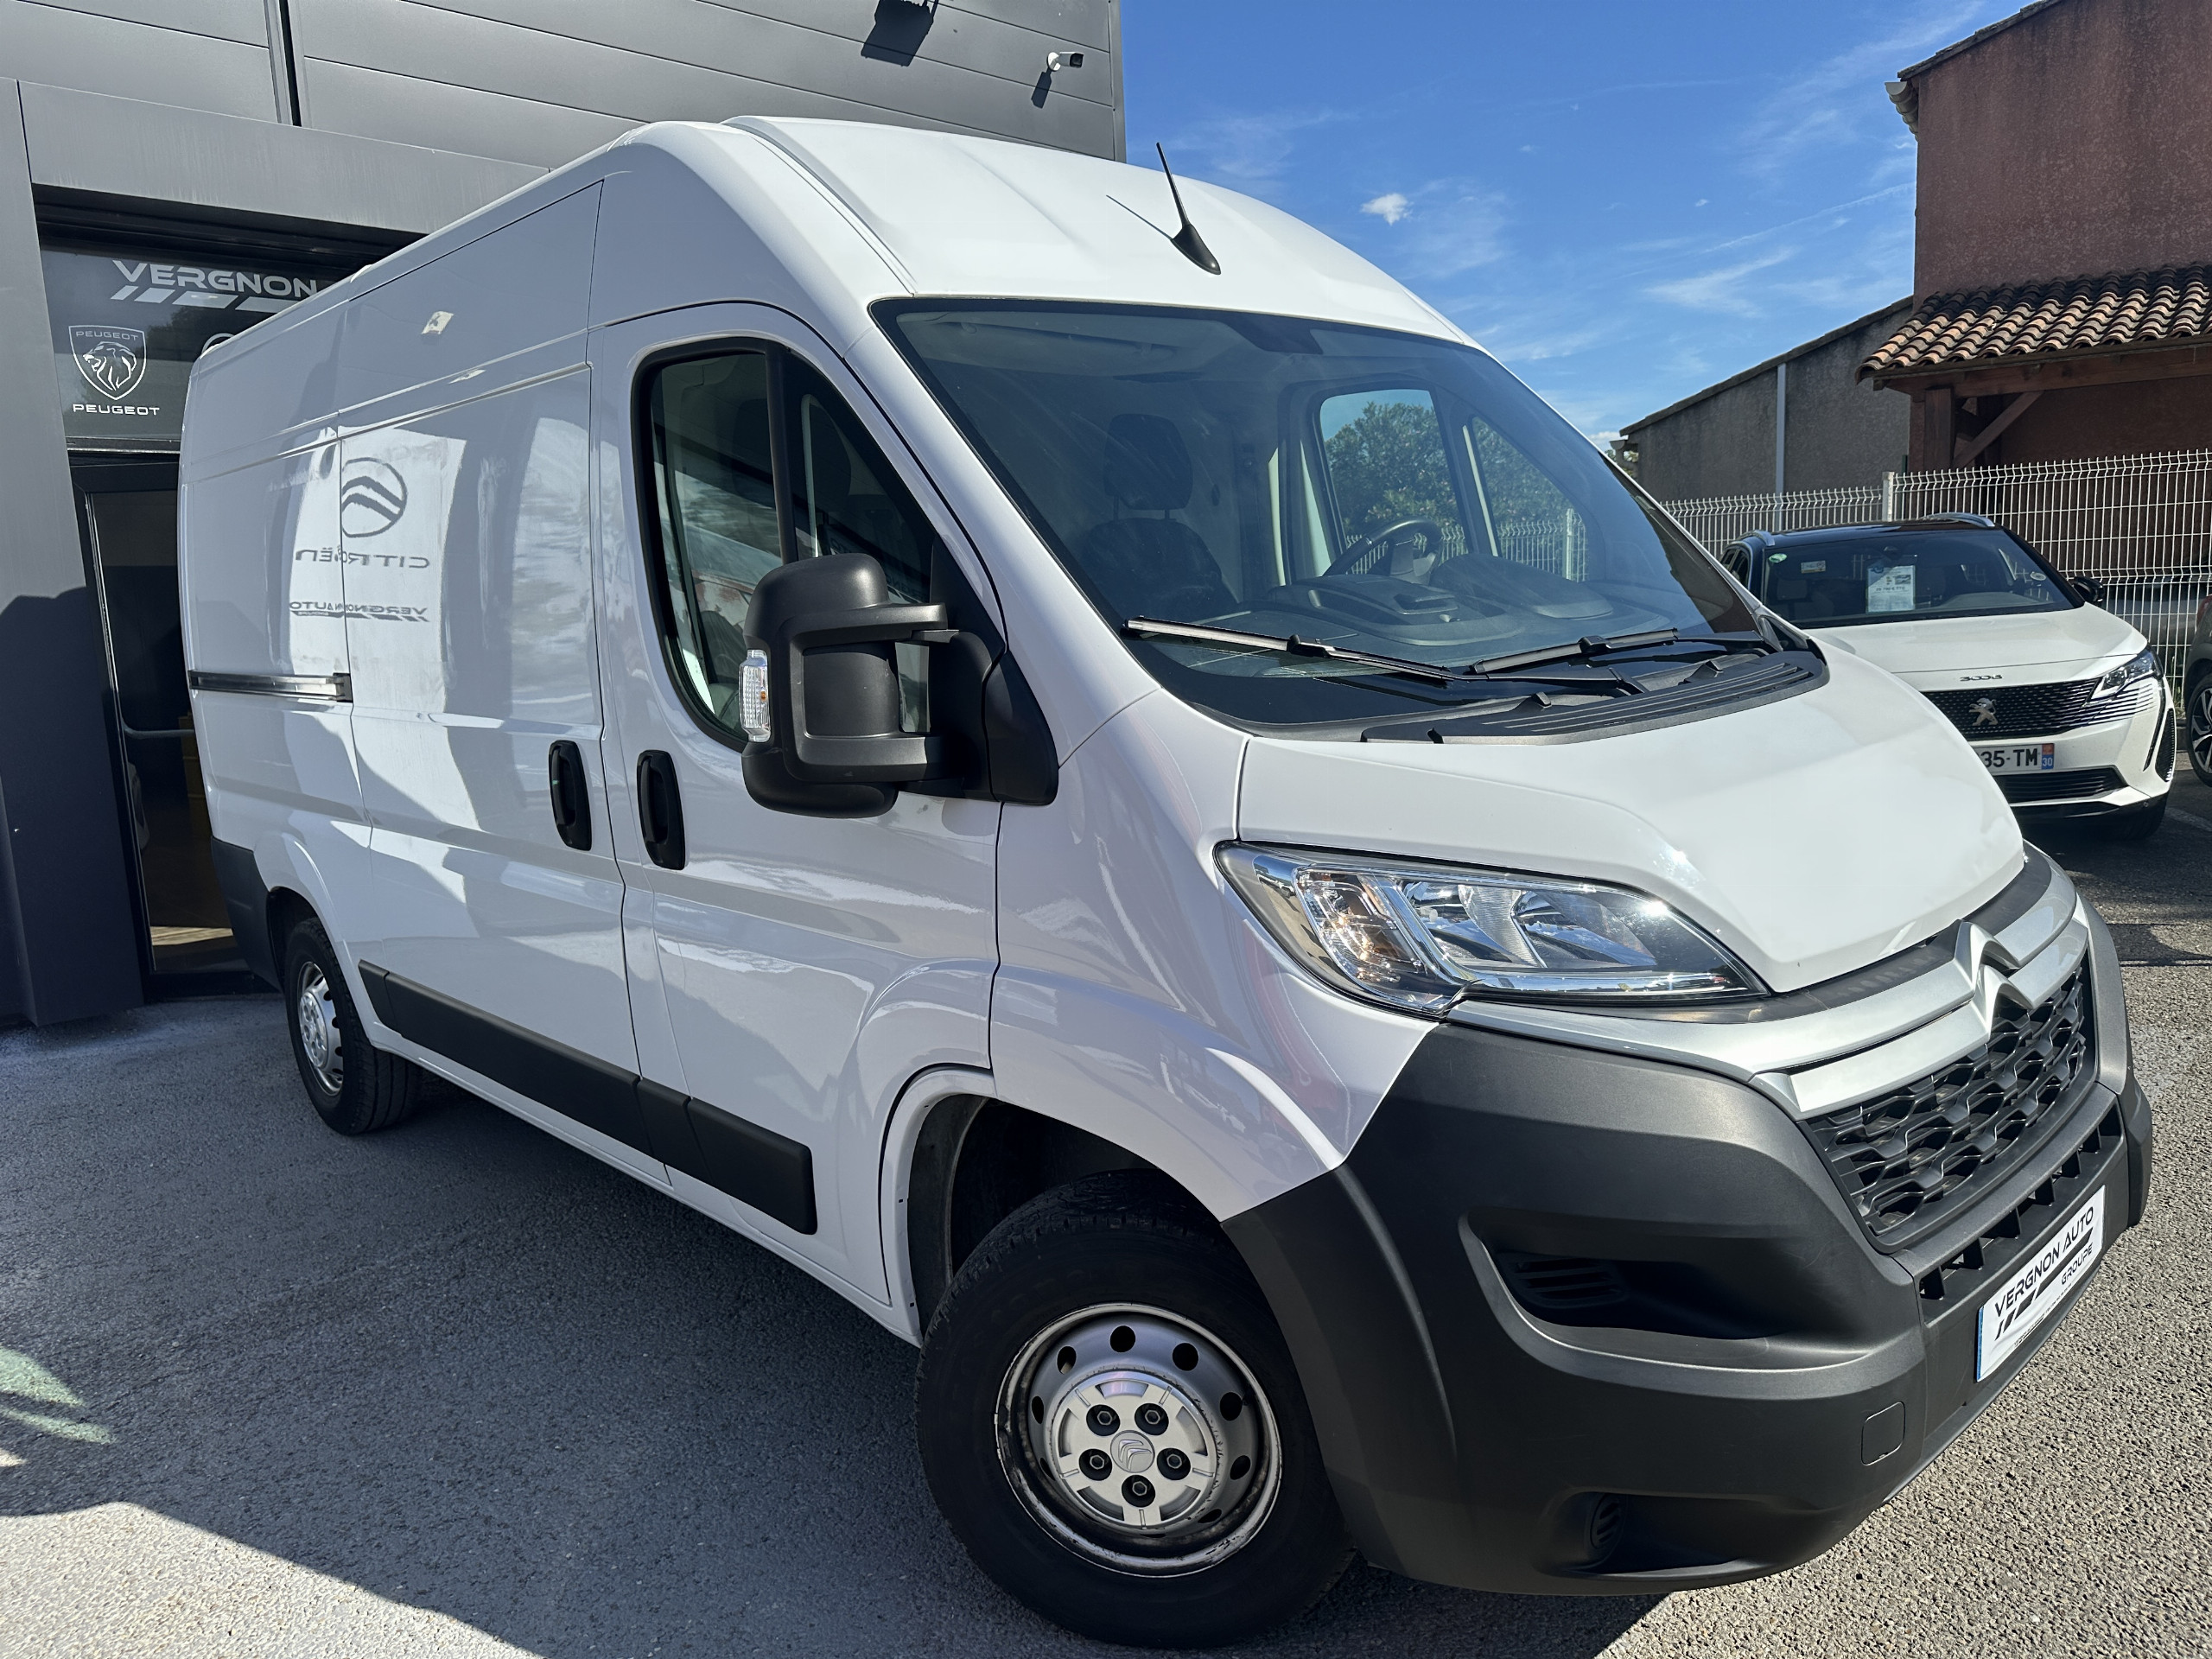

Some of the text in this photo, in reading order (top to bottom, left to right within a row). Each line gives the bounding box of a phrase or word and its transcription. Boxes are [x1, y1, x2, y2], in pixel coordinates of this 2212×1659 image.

[112, 259, 317, 298] VERGNON
[75, 330, 139, 342] PEUGEOT
[73, 403, 160, 416] PEUGEOT
[2042, 757, 2053, 766] 30
[1994, 1242, 2061, 1318] VERGNON
[2063, 1206, 2094, 1254] AUTO
[2061, 1242, 2093, 1285] GROUPE
